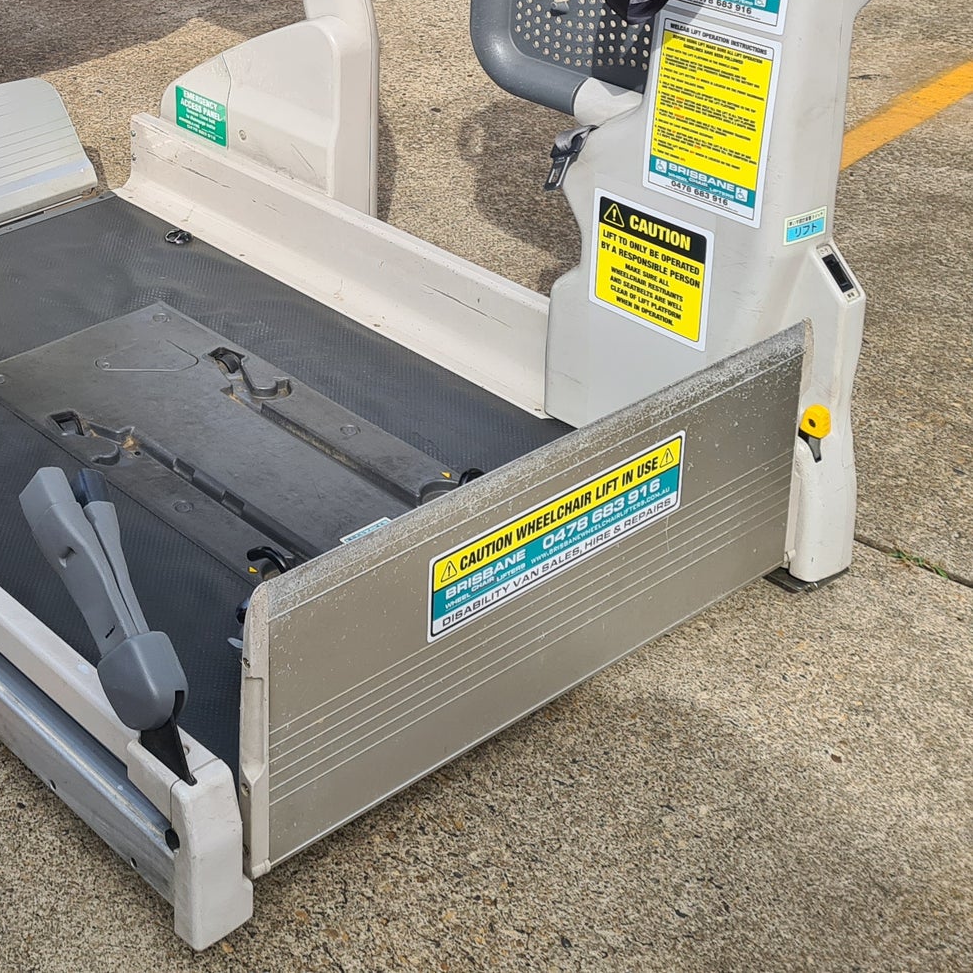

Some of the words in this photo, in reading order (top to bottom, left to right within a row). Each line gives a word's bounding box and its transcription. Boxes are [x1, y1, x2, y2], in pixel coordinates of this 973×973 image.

[716, 0, 732, 9] 683
[736, 4, 752, 14] 916
[691, 28, 701, 36] LIFT
[702, 31, 729, 44] OPERATION
[731, 38, 767, 55] INSTRUCTIONS
[668, 163, 735, 192] BRISBANE
[671, 180, 692, 192] 0478
[694, 189, 710, 199] 683
[712, 195, 728, 206] 916
[629, 214, 691, 251] CAUTION
[795, 223, 817, 237] リフト
[601, 240, 611, 251] BY
[611, 245, 617, 254] A
[618, 248, 668, 276] RESPONSIBLE
[670, 269, 701, 289] PERSON
[603, 229, 617, 242] LIFT
[619, 235, 628, 246] TO
[629, 238, 647, 254] ONLY
[649, 248, 660, 259] BE
[661, 253, 700, 276] OPERATED
[610, 266, 647, 287] WHEELCHAIR
[648, 282, 683, 302] RESTRAINTS
[625, 263, 641, 275] MAKE
[642, 270, 658, 282] SURE
[659, 278, 670, 287] ALL
[610, 275, 622, 285] AND
[623, 280, 653, 299] SEATBELTS
[654, 294, 666, 304] ARE
[667, 299, 684, 312] WELL
[610, 284, 628, 297] CLEAR
[629, 292, 637, 300] OF
[638, 296, 649, 307] LIFT
[650, 301, 681, 320] PLATFORM
[616, 295, 632, 308] WHEN
[633, 303, 640, 311] IN
[641, 306, 674, 326] OPERATION.
[459, 532, 513, 571] CAUTION
[516, 491, 592, 542] WHEELCHAIR
[595, 476, 619, 501] LIFT
[622, 469, 634, 487] IN
[637, 456, 658, 479] USE
[445, 548, 526, 600] BRISBANE
[542, 516, 589, 549] 0478
[591, 497, 625, 524] 683
[627, 478, 660, 505] 916
[442, 583, 511, 627] DISABILITY
[513, 568, 539, 587] VAN
[542, 547, 583, 573] SALES,
[584, 531, 611, 550] HIRE
[613, 524, 621, 534] &
[624, 497, 672, 529] REPAIRS
[445, 592, 471, 609] WHEEL
[471, 576, 495, 593] CHAIR
[497, 563, 526, 582] LIFTERS
